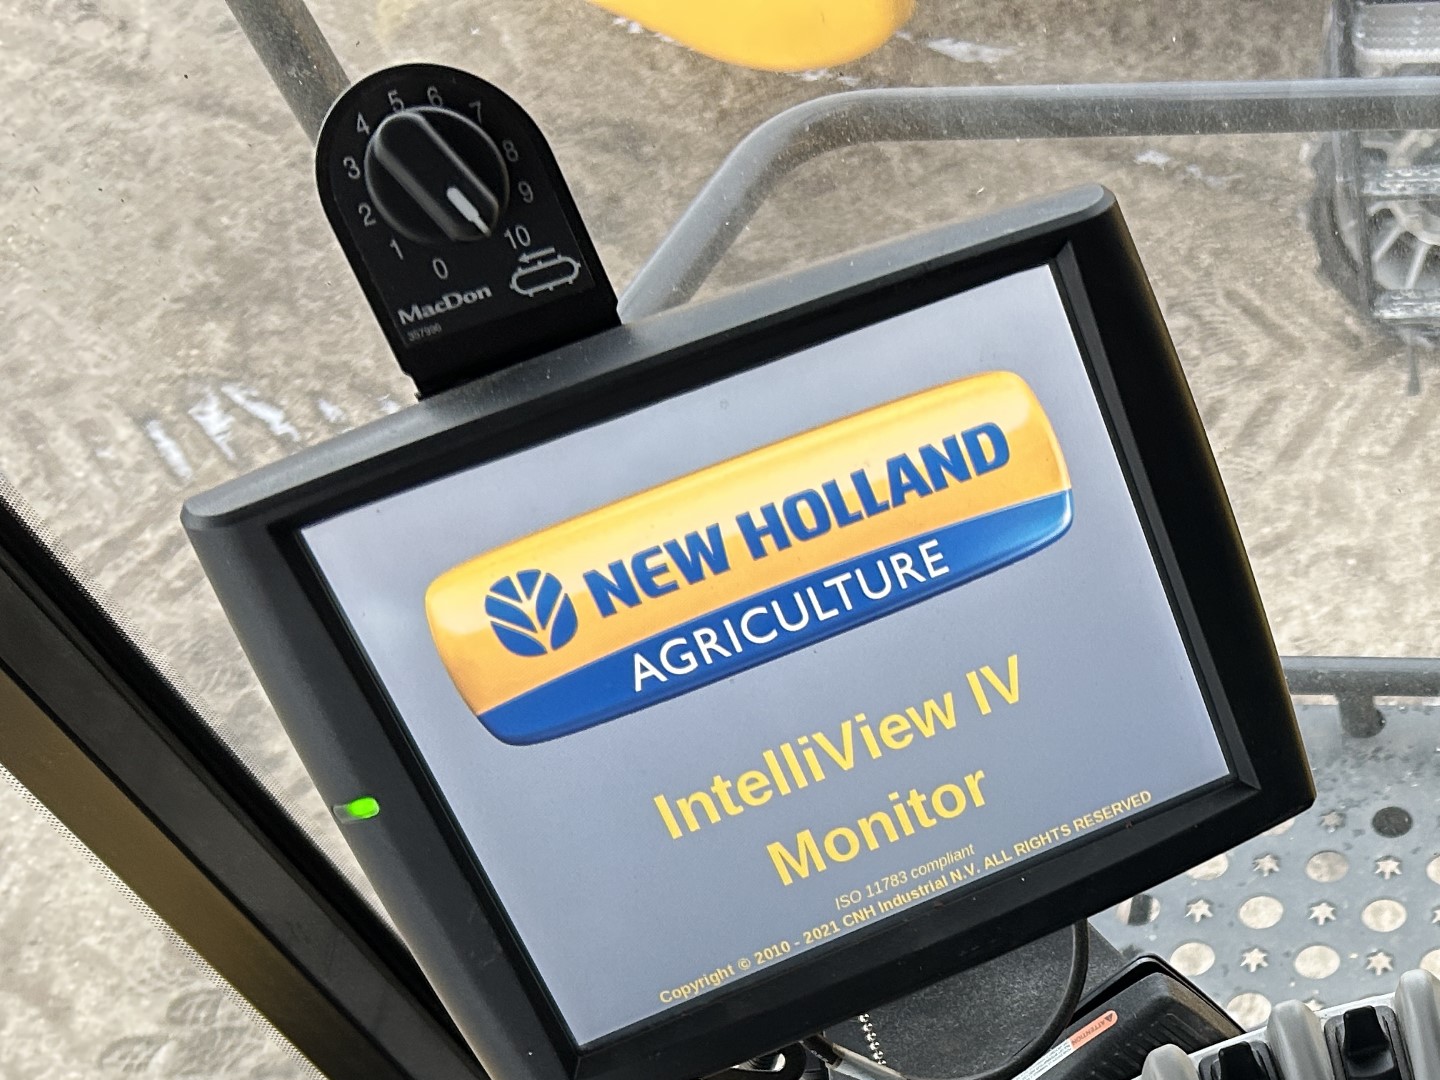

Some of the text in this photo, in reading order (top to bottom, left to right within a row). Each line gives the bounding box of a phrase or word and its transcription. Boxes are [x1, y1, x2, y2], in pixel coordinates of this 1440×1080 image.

[388, 89, 404, 113] 5
[427, 86, 443, 107] 6
[356, 112, 370, 135] 4
[469, 101, 482, 124] 7
[502, 139, 519, 162] 8
[343, 156, 361, 179] 3
[518, 181, 534, 203] 9
[358, 202, 376, 227] 2
[504, 225, 531, 249] 10
[390, 239, 404, 260] 1
[432, 257, 448, 280] 0
[397, 286, 492, 325] MacDon
[582, 422, 1011, 618] NEW HOLLAND
[631, 539, 949, 691] AGRICULTURE
[653, 654, 1020, 840] IntelliView IV
[765, 769, 987, 886] Monitor
[835, 843, 976, 910] ISO 11783 compliant
[659, 963, 736, 1004] Copyright
[753, 940, 791, 965] 2010
[802, 920, 841, 945] 2021
[842, 906, 877, 927] CNH
[877, 870, 949, 913] Industrial
[949, 863, 981, 885] N.V.
[983, 850, 1013, 870] ALL
[1013, 824, 1072, 857] RIGHTS
[1072, 790, 1152, 833] RESERVED
[1072, 1019, 1105, 1046] ATTENTION
